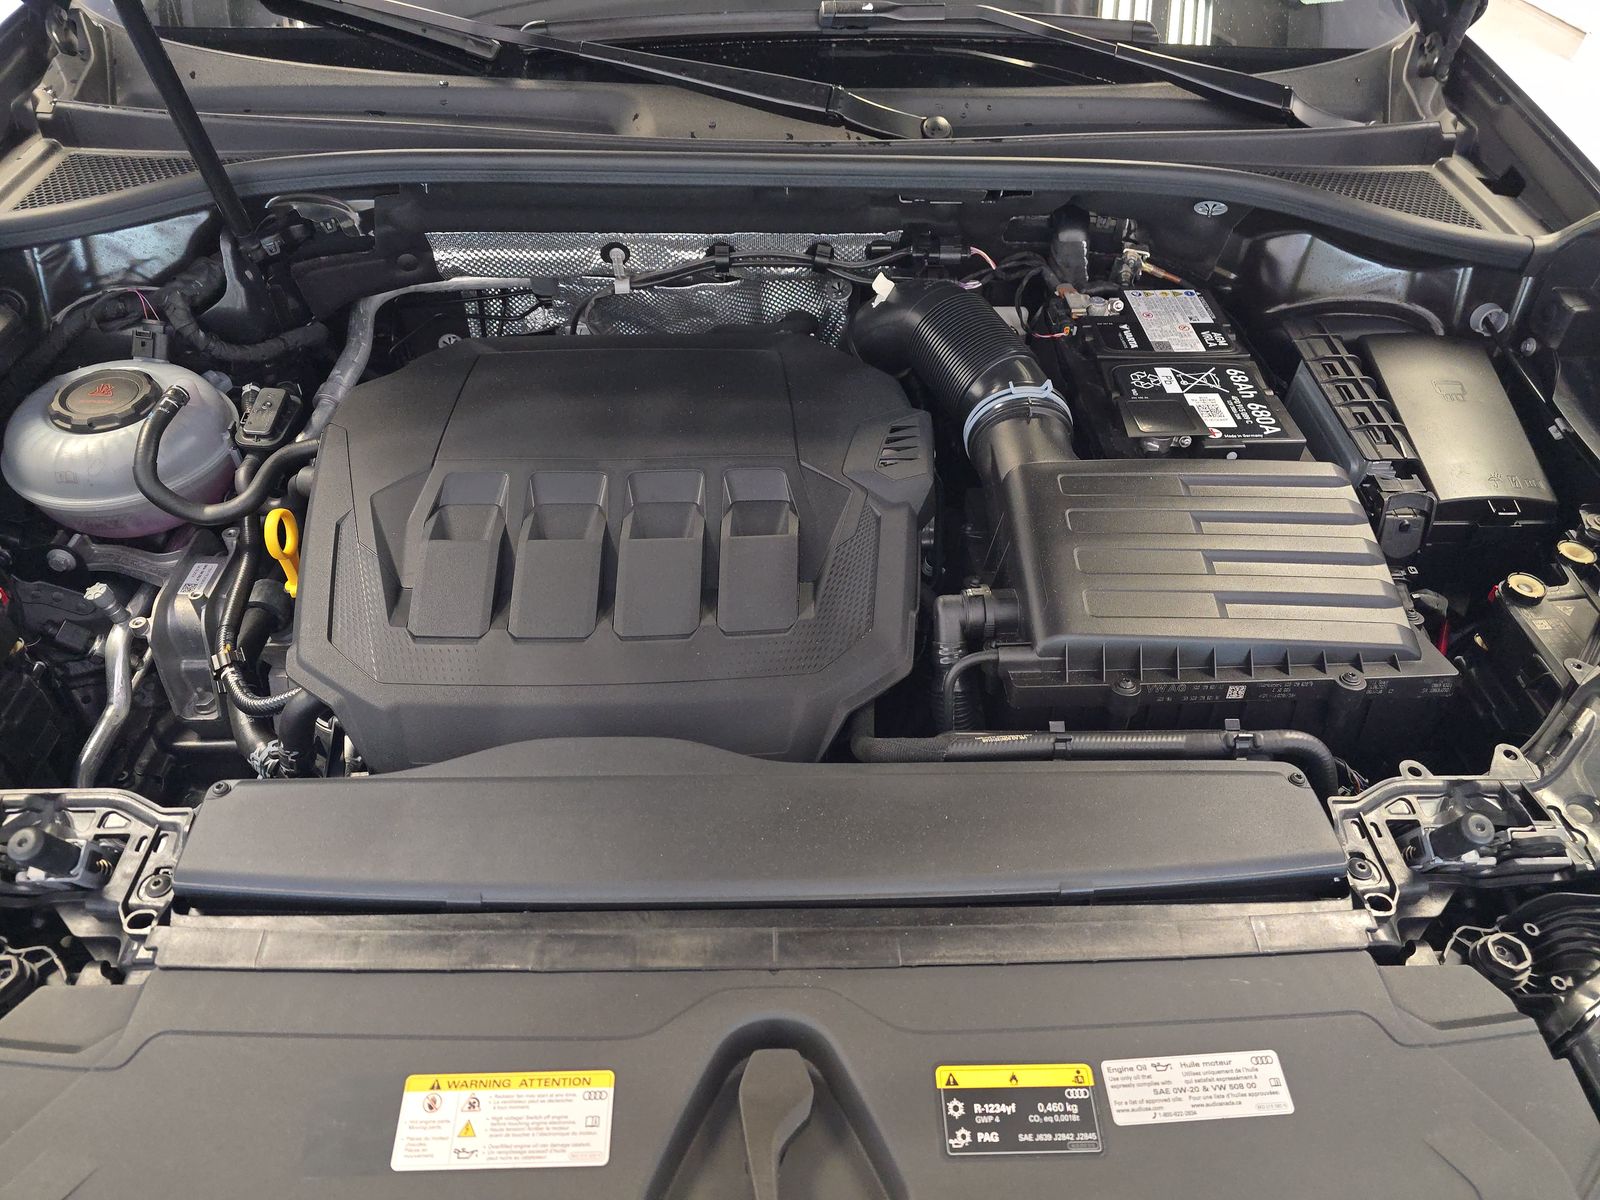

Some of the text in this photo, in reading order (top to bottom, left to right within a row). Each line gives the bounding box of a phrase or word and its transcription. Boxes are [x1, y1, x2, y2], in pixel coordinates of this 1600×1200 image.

[1123, 330, 1139, 349] VARTA
[1201, 331, 1217, 347] VRLA
[1211, 332, 1228, 346] AGM
[1161, 375, 1173, 385] Pb
[1226, 368, 1257, 399] 68Ah
[1247, 402, 1282, 435] 680A
[447, 1077, 592, 1089] WARNING ATTENTION
[1172, 1086, 1200, 1094] 0W-20
[973, 1102, 1016, 1115] R-1234yf
[1037, 1102, 1079, 1114] 0,460 kg
[975, 1115, 1000, 1124] GWP 4
[1044, 1115, 1053, 1124] eq
[977, 1131, 1000, 1143] PAG
[1018, 1133, 1034, 1142] SAE
[1053, 1132, 1075, 1141] J2842
[1075, 1131, 1098, 1141] J2845
